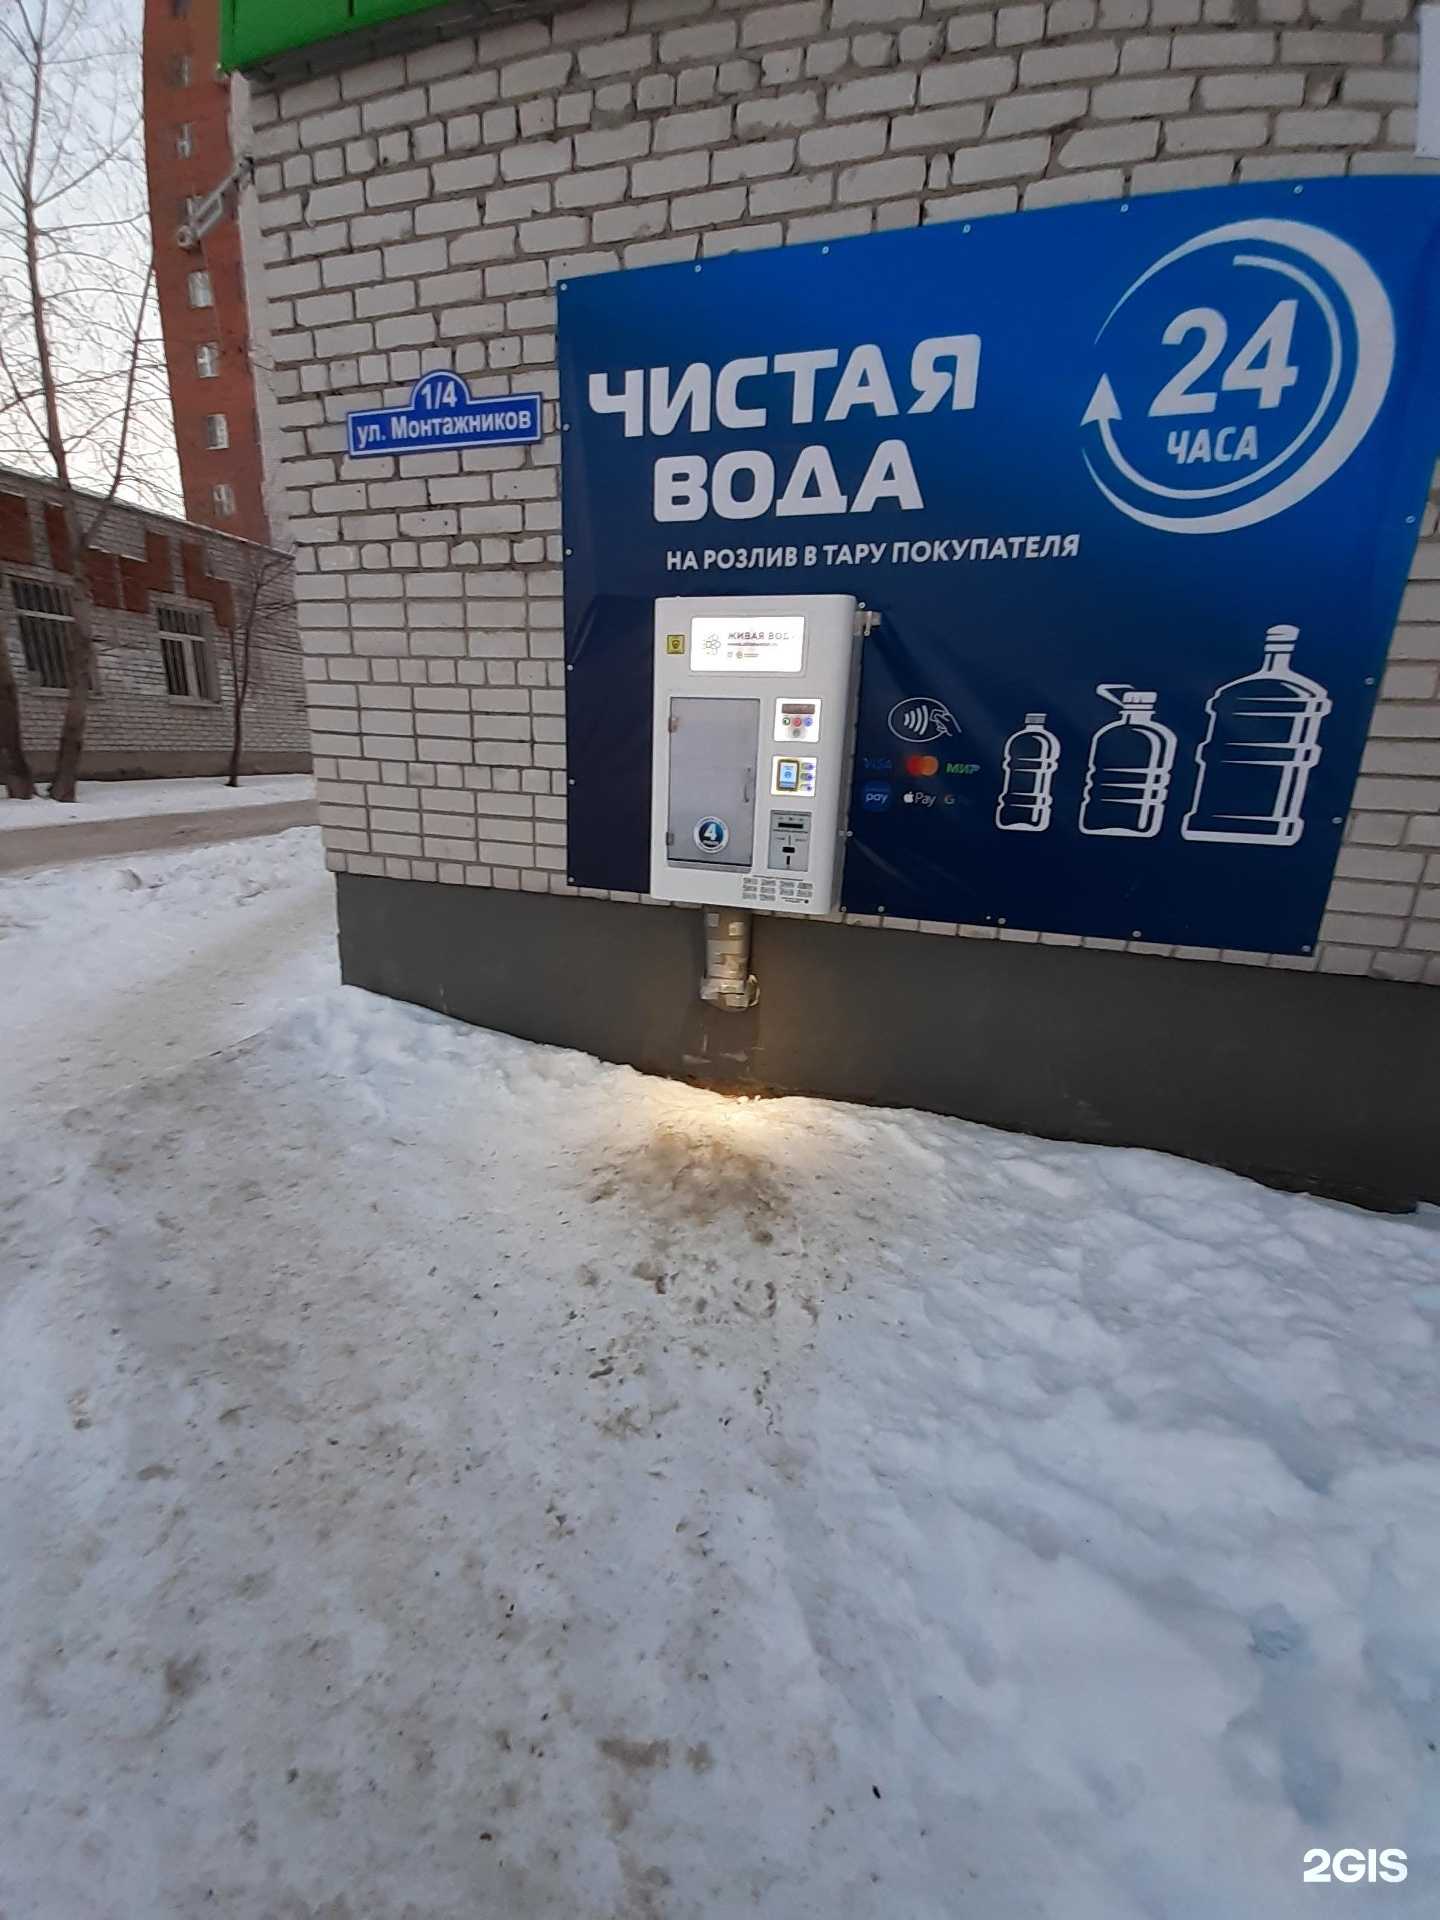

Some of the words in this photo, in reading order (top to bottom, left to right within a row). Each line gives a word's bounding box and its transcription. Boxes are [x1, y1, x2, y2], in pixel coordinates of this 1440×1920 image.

[1148, 299, 1299, 417] 24
[421, 381, 458, 410] 1/4
[588, 334, 982, 437] ЧИСТАЯ
[357, 423, 386, 448] ул.
[391, 410, 532, 439] Монтажников
[1166, 426, 1259, 464] ЧАСА
[653, 439, 925, 522] ВОДА
[666, 549, 699, 571] НА
[703, 545, 799, 571] РОЗЛИВ
[804, 547, 818, 567] В
[822, 543, 887, 568] ТАРУ
[891, 533, 1081, 564] ПОКУПАТЕЛЯ
[727, 631, 765, 640] ЖИВАЯ
[945, 763, 981, 774] МИР
[865, 793, 888, 805] pay
[914, 792, 937, 807] Pay
[703, 823, 718, 841] 4
